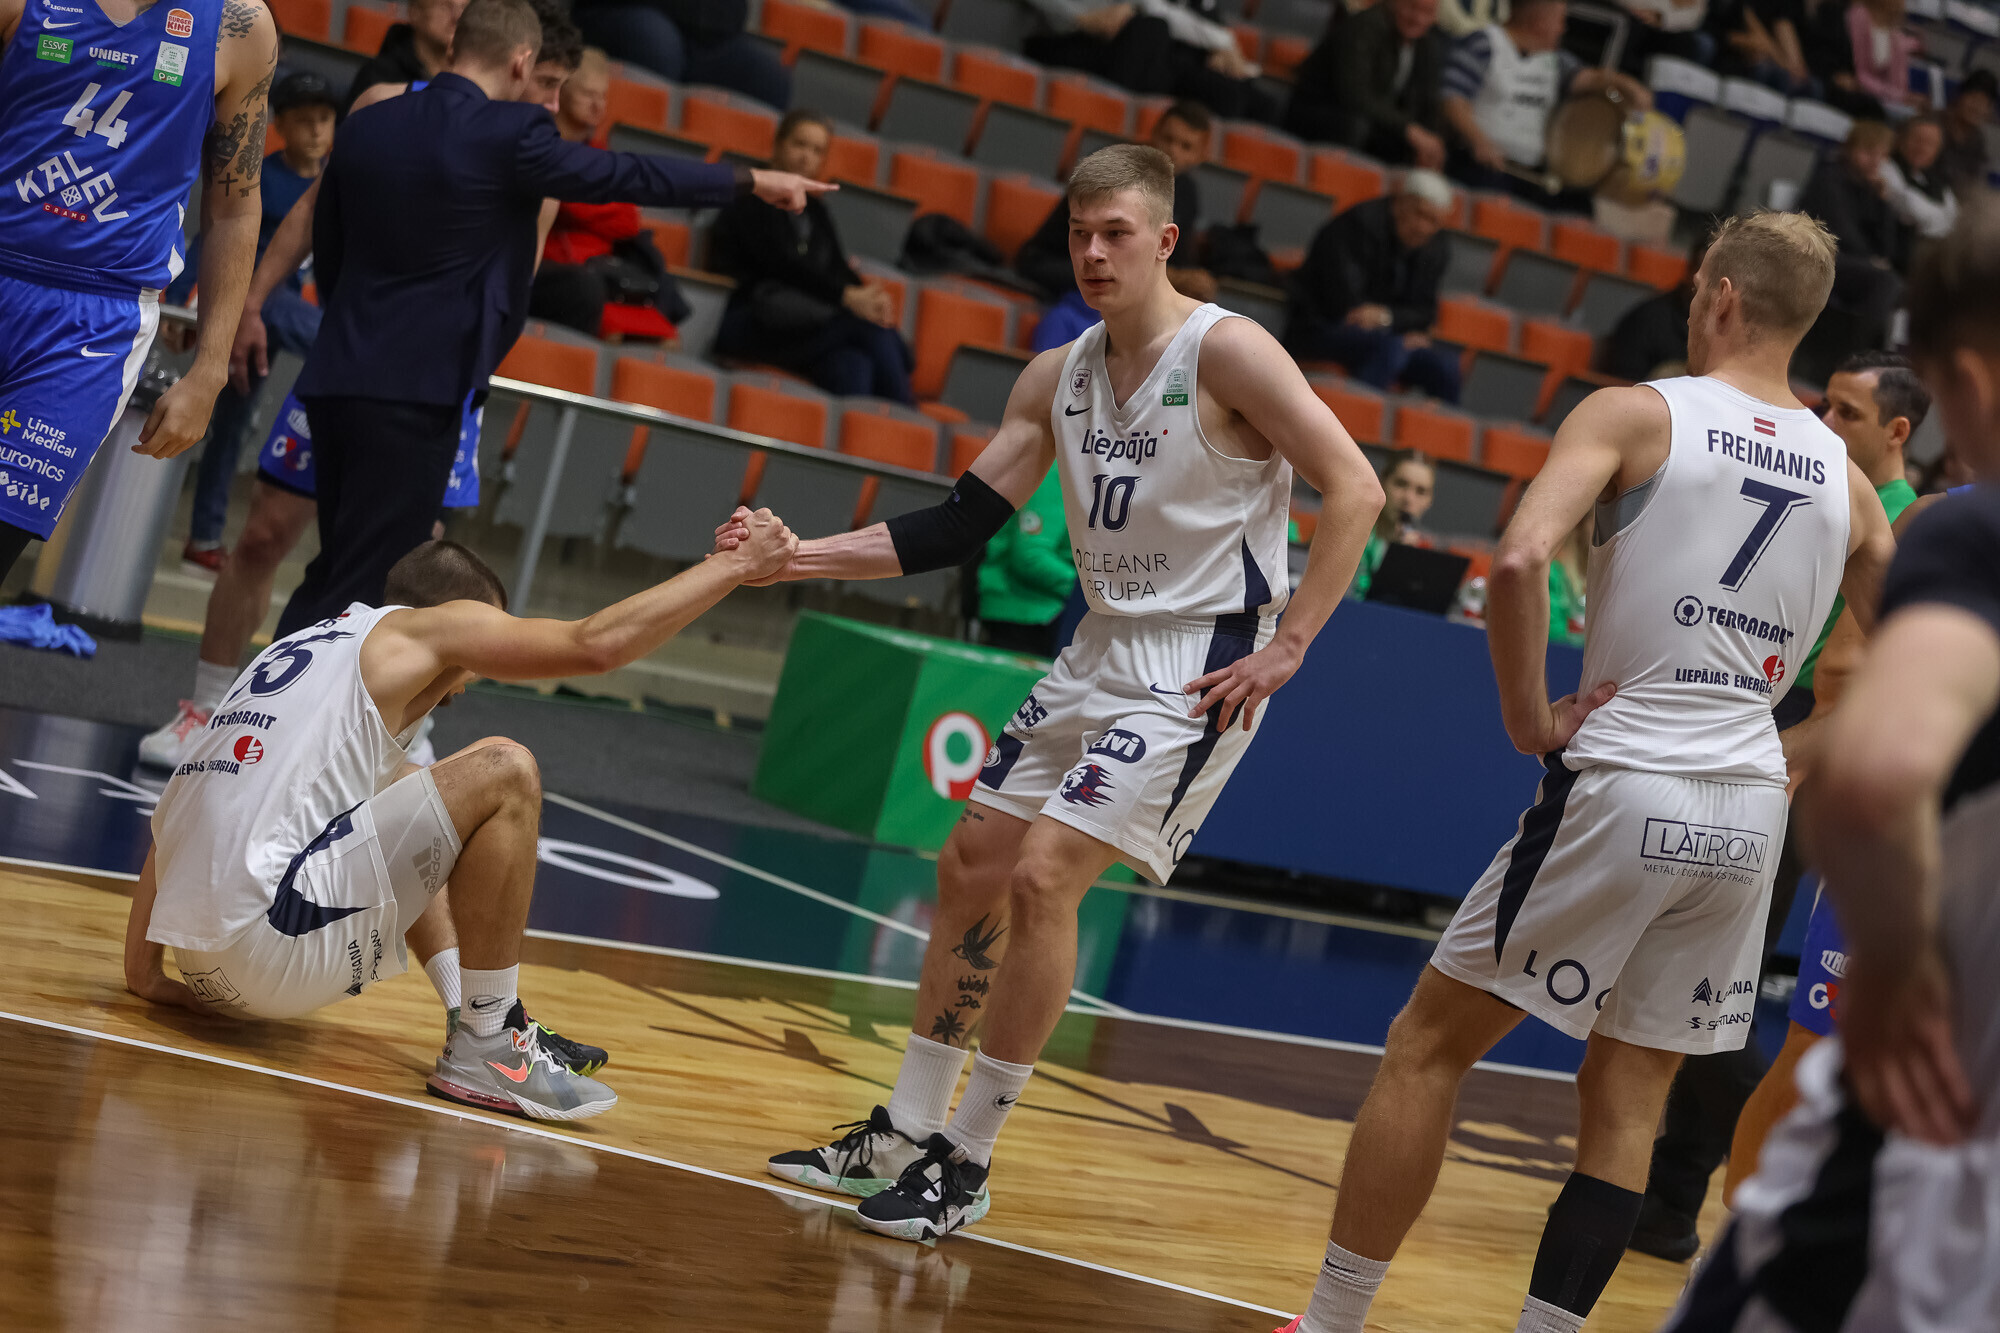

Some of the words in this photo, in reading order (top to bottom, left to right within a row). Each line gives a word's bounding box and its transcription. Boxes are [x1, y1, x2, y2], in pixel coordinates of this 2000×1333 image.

[50, 3, 84, 14] LIGNATOR
[168, 15, 192, 26] BURGER
[167, 20, 191, 33] KING
[42, 39, 69, 52] ESSVE
[89, 46, 139, 66] UNIBET
[61, 82, 134, 149] 44
[14, 150, 130, 223] KALEV
[43, 202, 88, 223] CRAMO
[27, 417, 67, 441] Linus
[21, 428, 78, 459] Medical
[1706, 428, 1826, 486] FREIMANIS
[1088, 473, 1143, 533] 10
[1718, 476, 1815, 593] 7
[1086, 579, 1158, 601] GRUPA
[1707, 605, 1795, 646] TERRABALT
[1675, 668, 1729, 686] LIEPĀJAS
[428, 836, 442, 894] adidas
